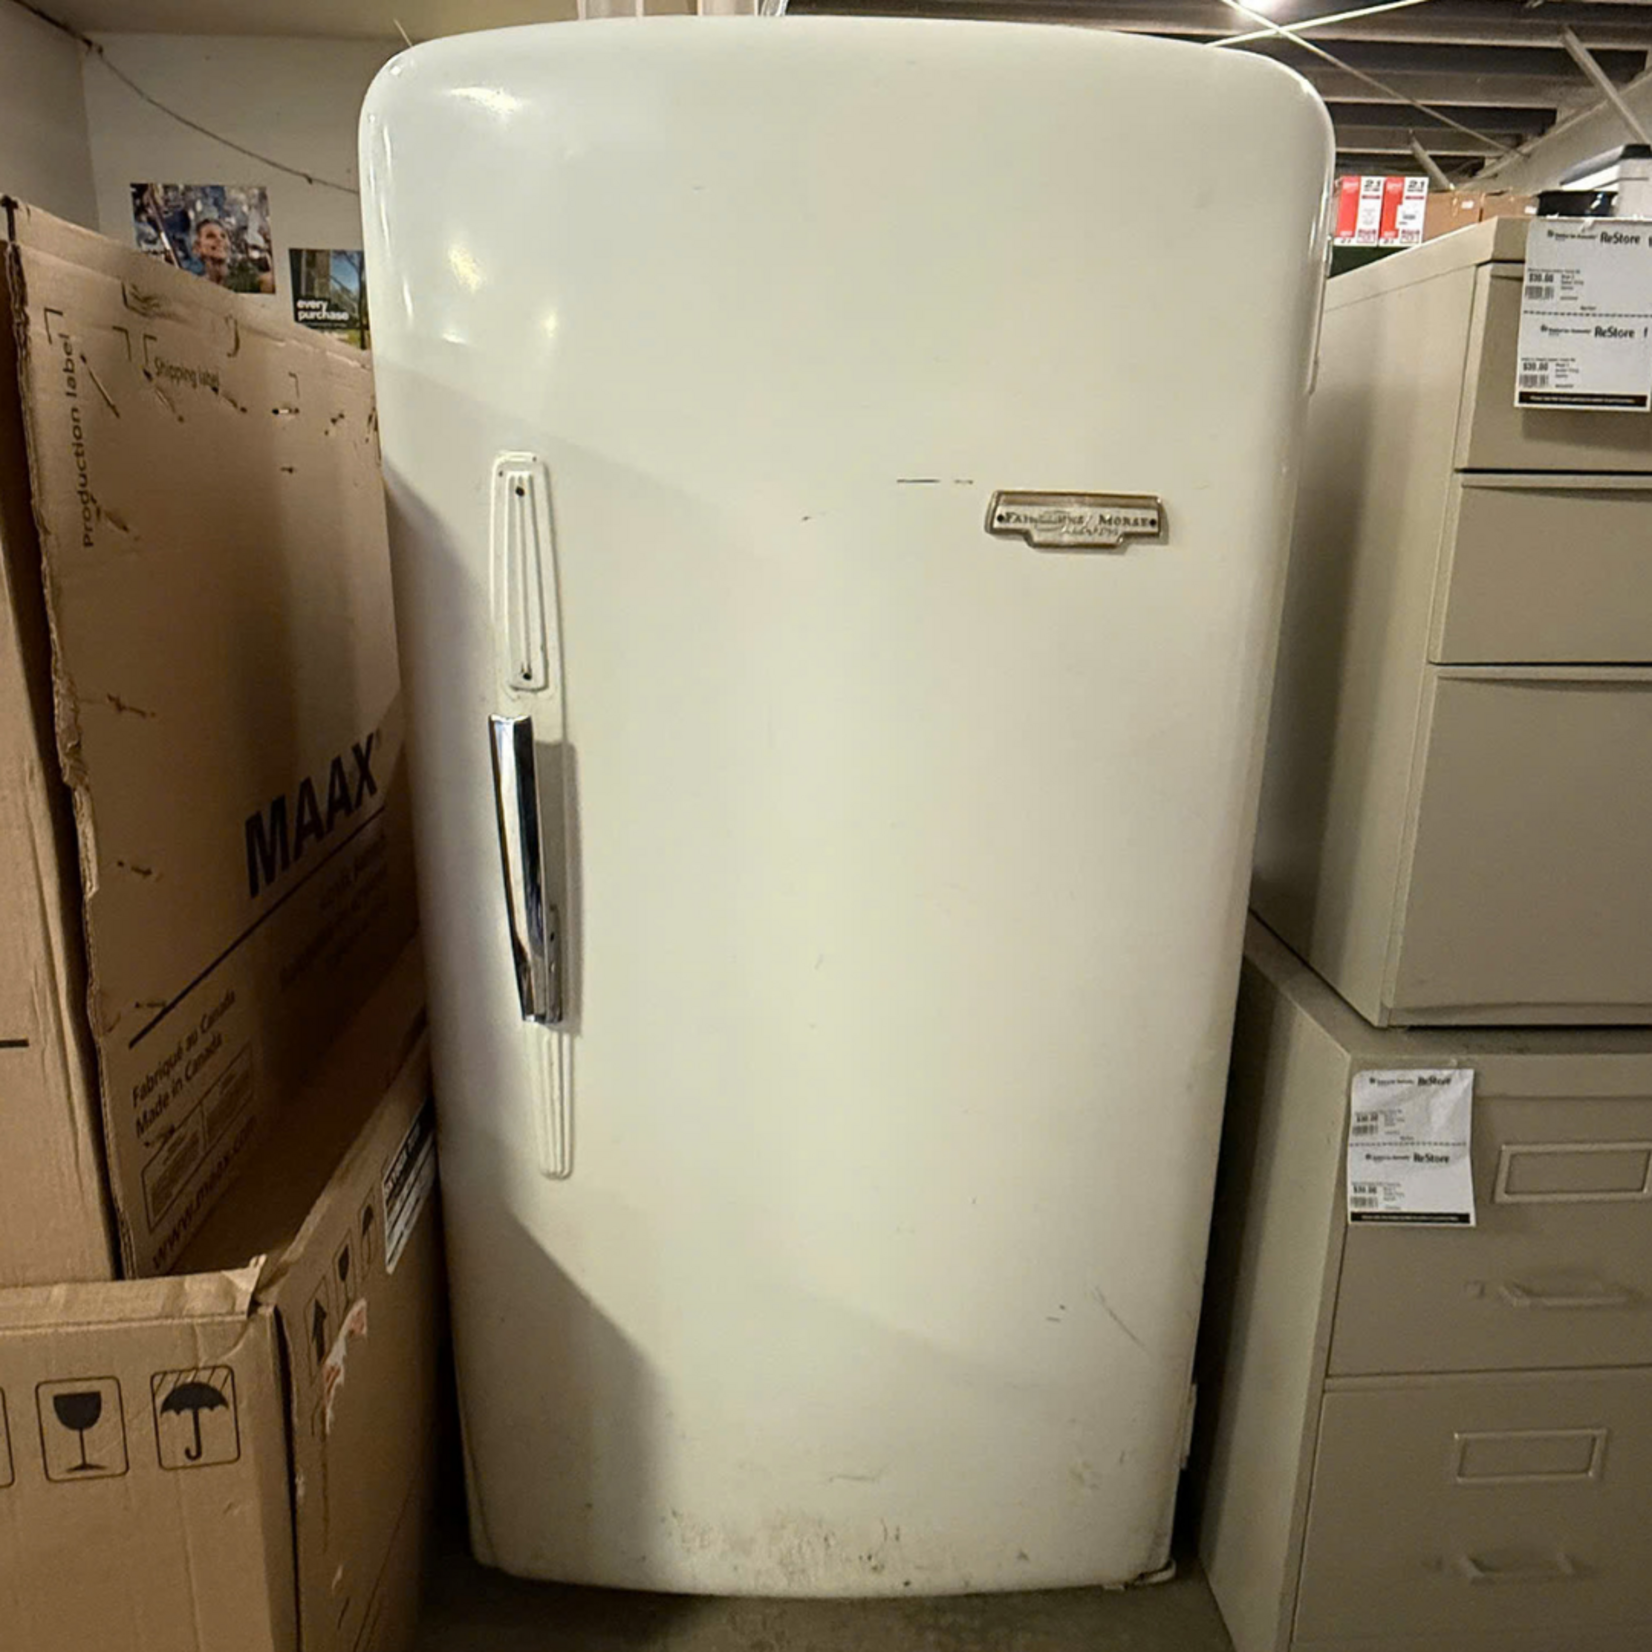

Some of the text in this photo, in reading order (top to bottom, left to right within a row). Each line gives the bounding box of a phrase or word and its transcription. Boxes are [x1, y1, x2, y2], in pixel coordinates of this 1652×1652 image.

[1600, 230, 1641, 245] ReStore
[297, 299, 328, 313] every
[298, 309, 349, 321] purchase
[1595, 325, 1635, 338] ReStore
[154, 356, 197, 389] Shipping
[62, 333, 95, 548] Production label
[1099, 514, 1150, 527] MORSE
[245, 732, 378, 898] MAAX
[132, 988, 236, 1109] Fabriqué au Canada
[135, 1032, 224, 1138] Made in Canada
